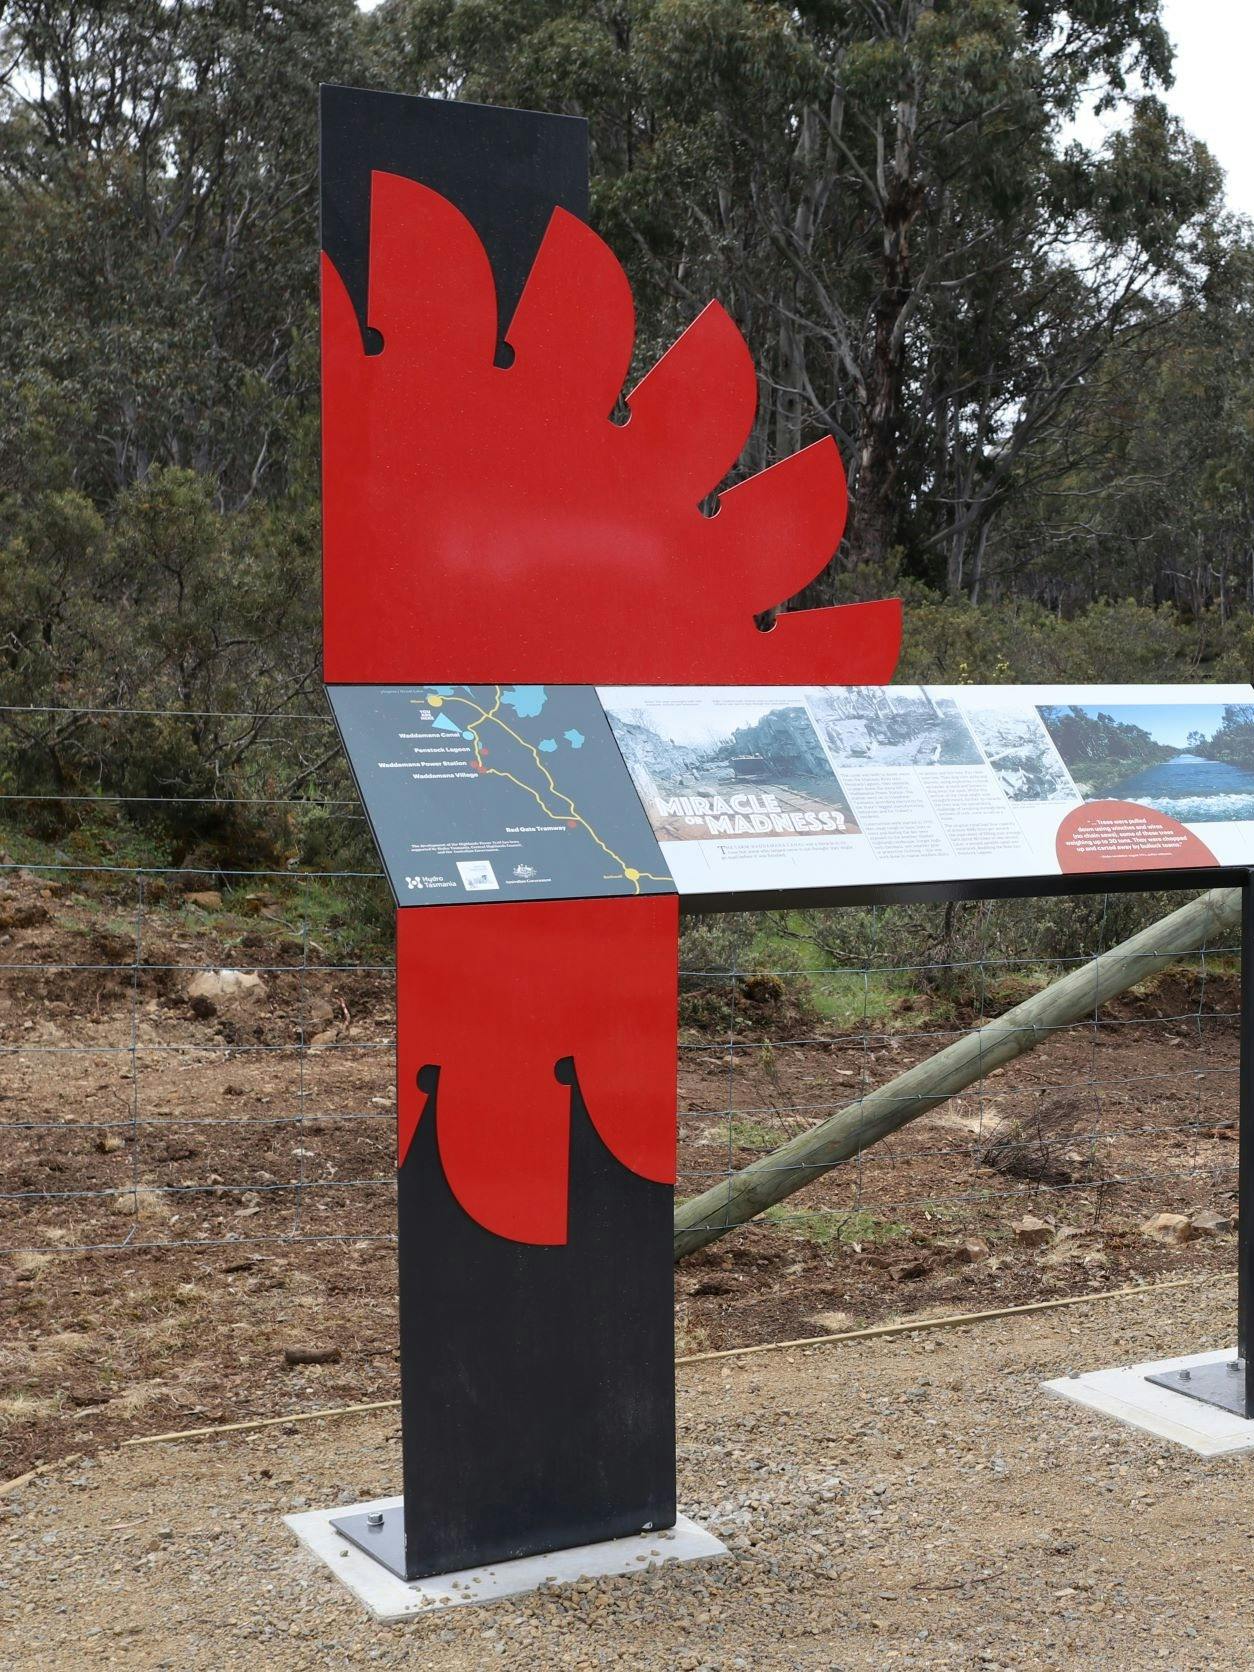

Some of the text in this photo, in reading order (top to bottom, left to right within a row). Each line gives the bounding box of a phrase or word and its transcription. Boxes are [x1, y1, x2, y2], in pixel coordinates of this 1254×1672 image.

[656, 794, 782, 817] MIRACLE
[684, 811, 846, 835] OR MADNESS?
[1162, 834, 1188, 843] chopped
